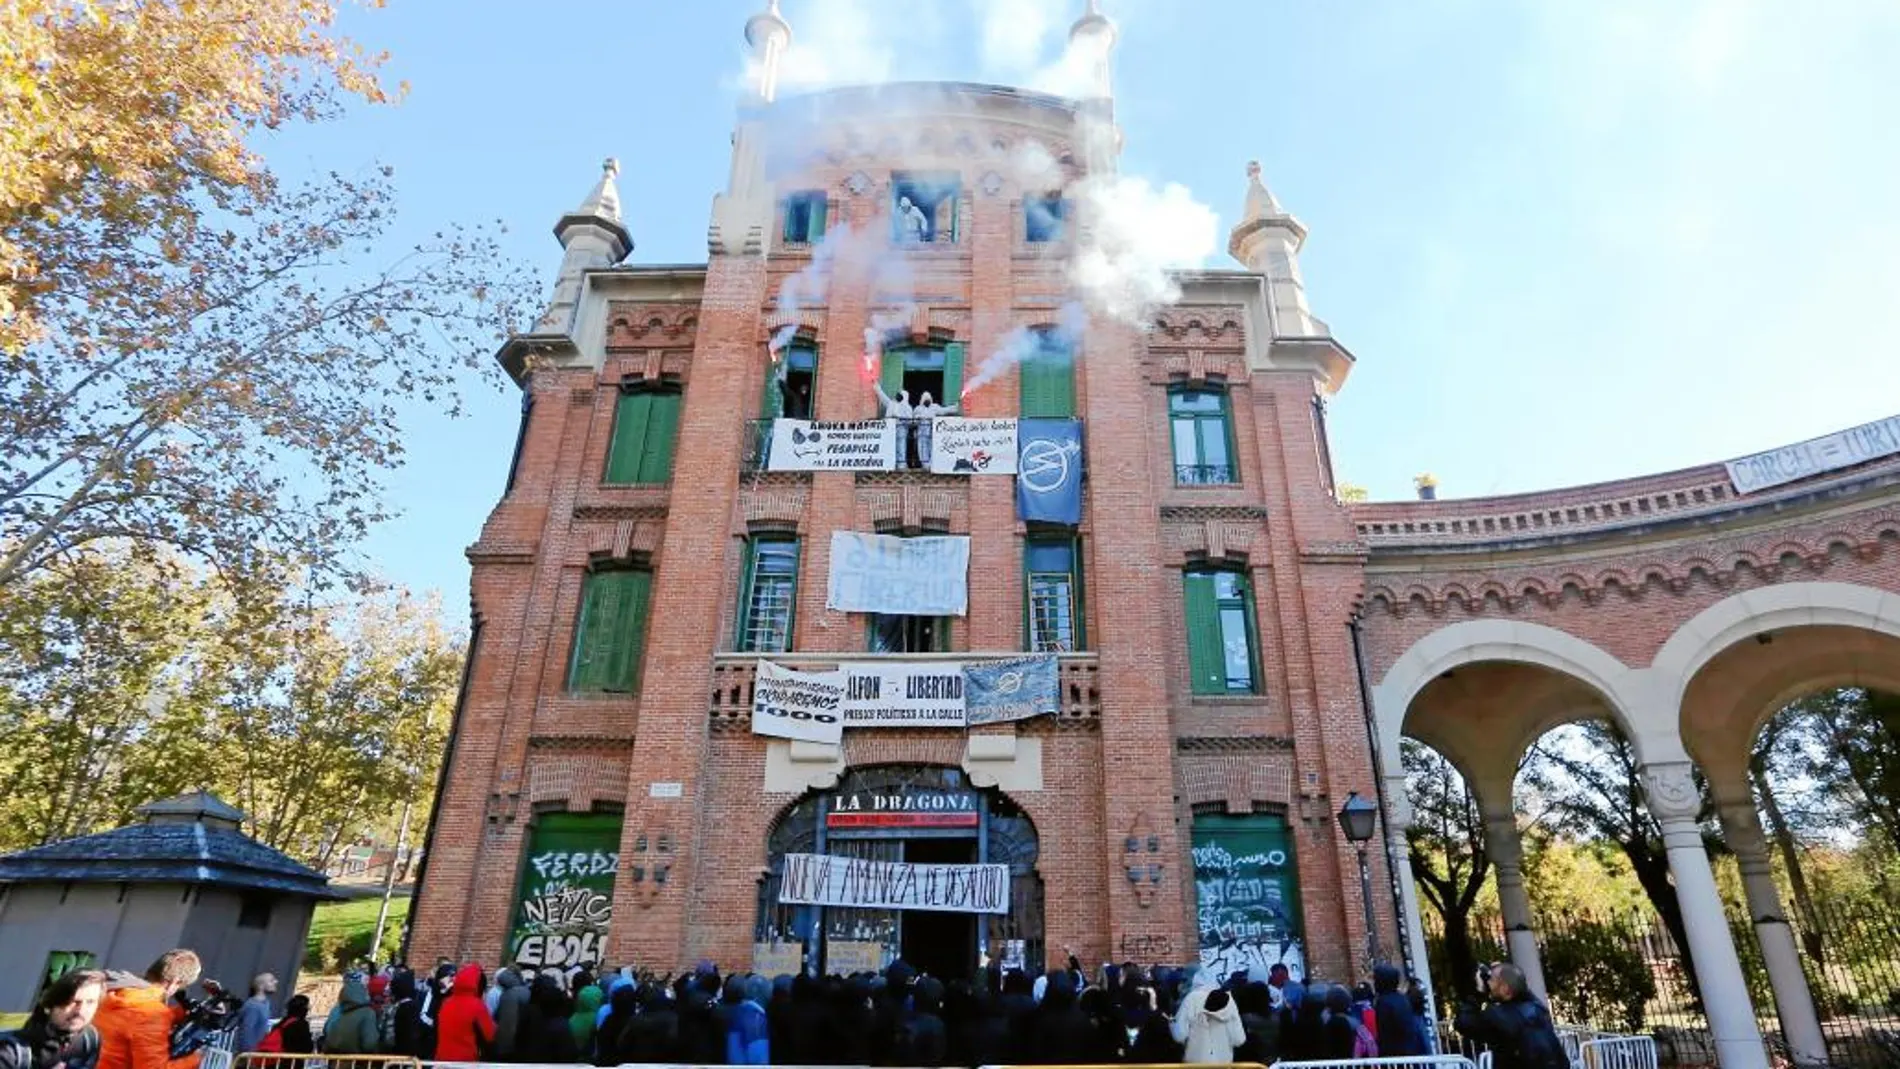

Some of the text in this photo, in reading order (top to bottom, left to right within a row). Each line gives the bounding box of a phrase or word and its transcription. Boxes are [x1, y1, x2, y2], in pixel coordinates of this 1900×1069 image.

[906, 675, 962, 699] LIBERTAD
[926, 709, 936, 719] LA
[938, 708, 963, 720] CALLE
[835, 793, 973, 811] LA DRAGONA
